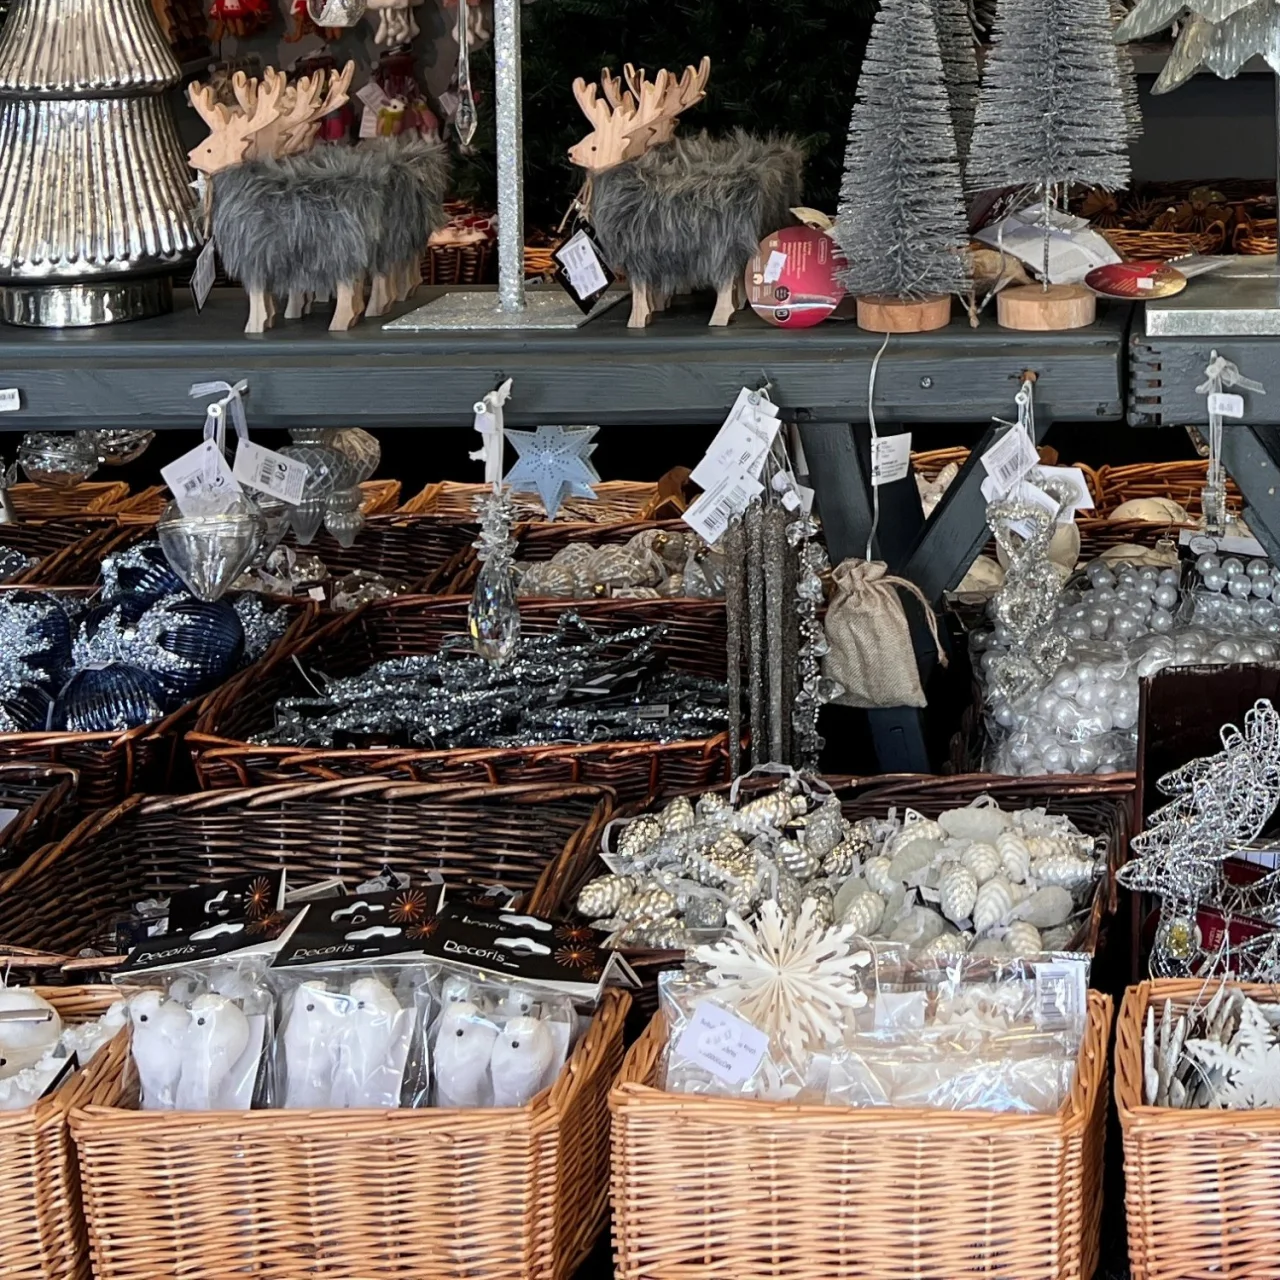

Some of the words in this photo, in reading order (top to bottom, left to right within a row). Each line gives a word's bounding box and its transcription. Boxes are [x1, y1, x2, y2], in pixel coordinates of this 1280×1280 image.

[134, 943, 197, 964] Decoris
[291, 943, 356, 959] Decoris
[444, 939, 506, 963] Decoris
